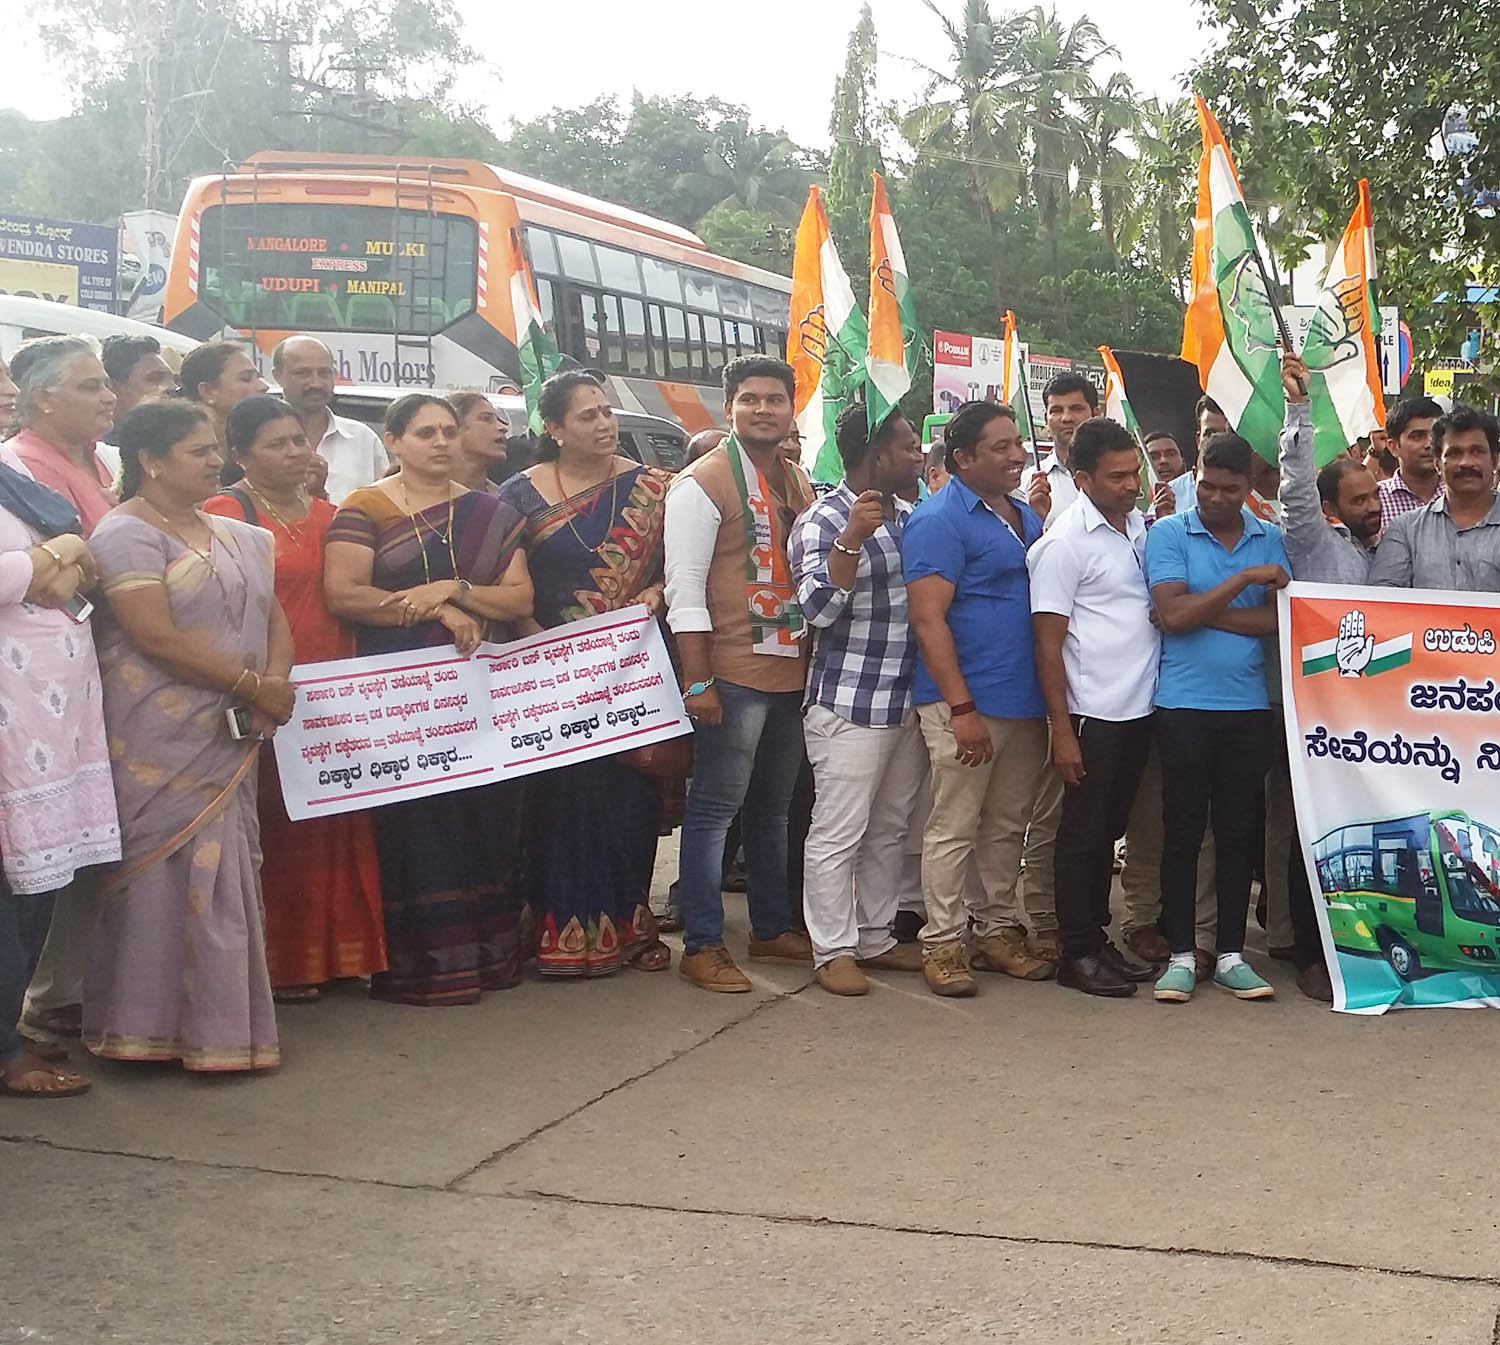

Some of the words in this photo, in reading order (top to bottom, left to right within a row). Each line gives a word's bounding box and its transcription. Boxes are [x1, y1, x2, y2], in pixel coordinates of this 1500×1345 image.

[57, 245, 109, 264] STORES
[312, 258, 367, 271] EXPRESS
[261, 277, 320, 292] UDUPI
[1424, 624, 1495, 654] ಉಡುಪಿ
[1305, 727, 1460, 784] ಸೇವೆಯನ್ನು
